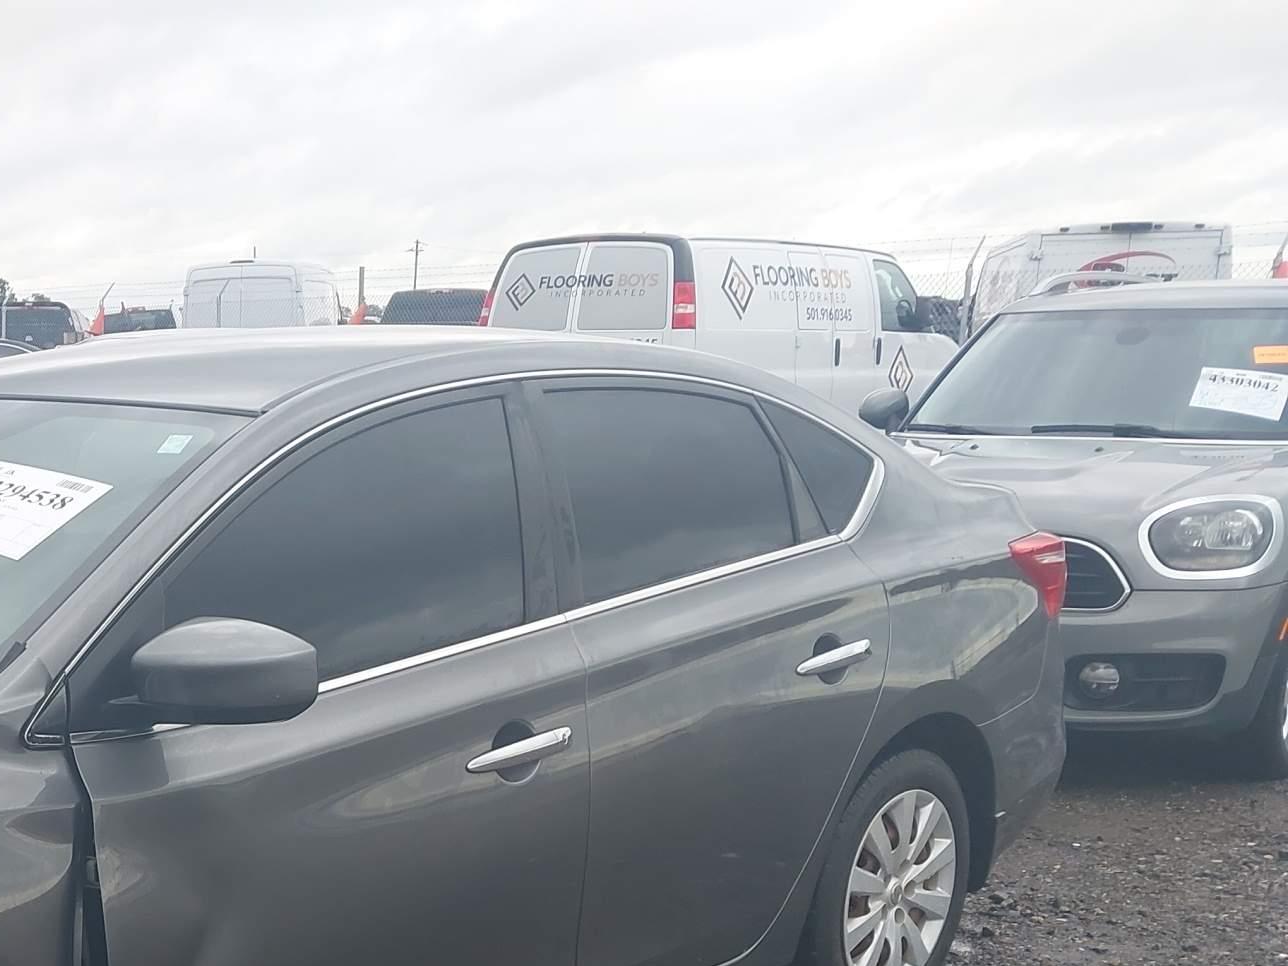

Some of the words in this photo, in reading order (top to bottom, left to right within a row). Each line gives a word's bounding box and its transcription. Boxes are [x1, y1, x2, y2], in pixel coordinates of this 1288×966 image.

[539, 274, 614, 289] FLOORING
[617, 273, 660, 287] BOYS
[752, 265, 819, 288] FLOORING
[820, 268, 852, 290] BOYS
[550, 288, 647, 298] INCORPORATED
[769, 290, 847, 304] INCORPORATED
